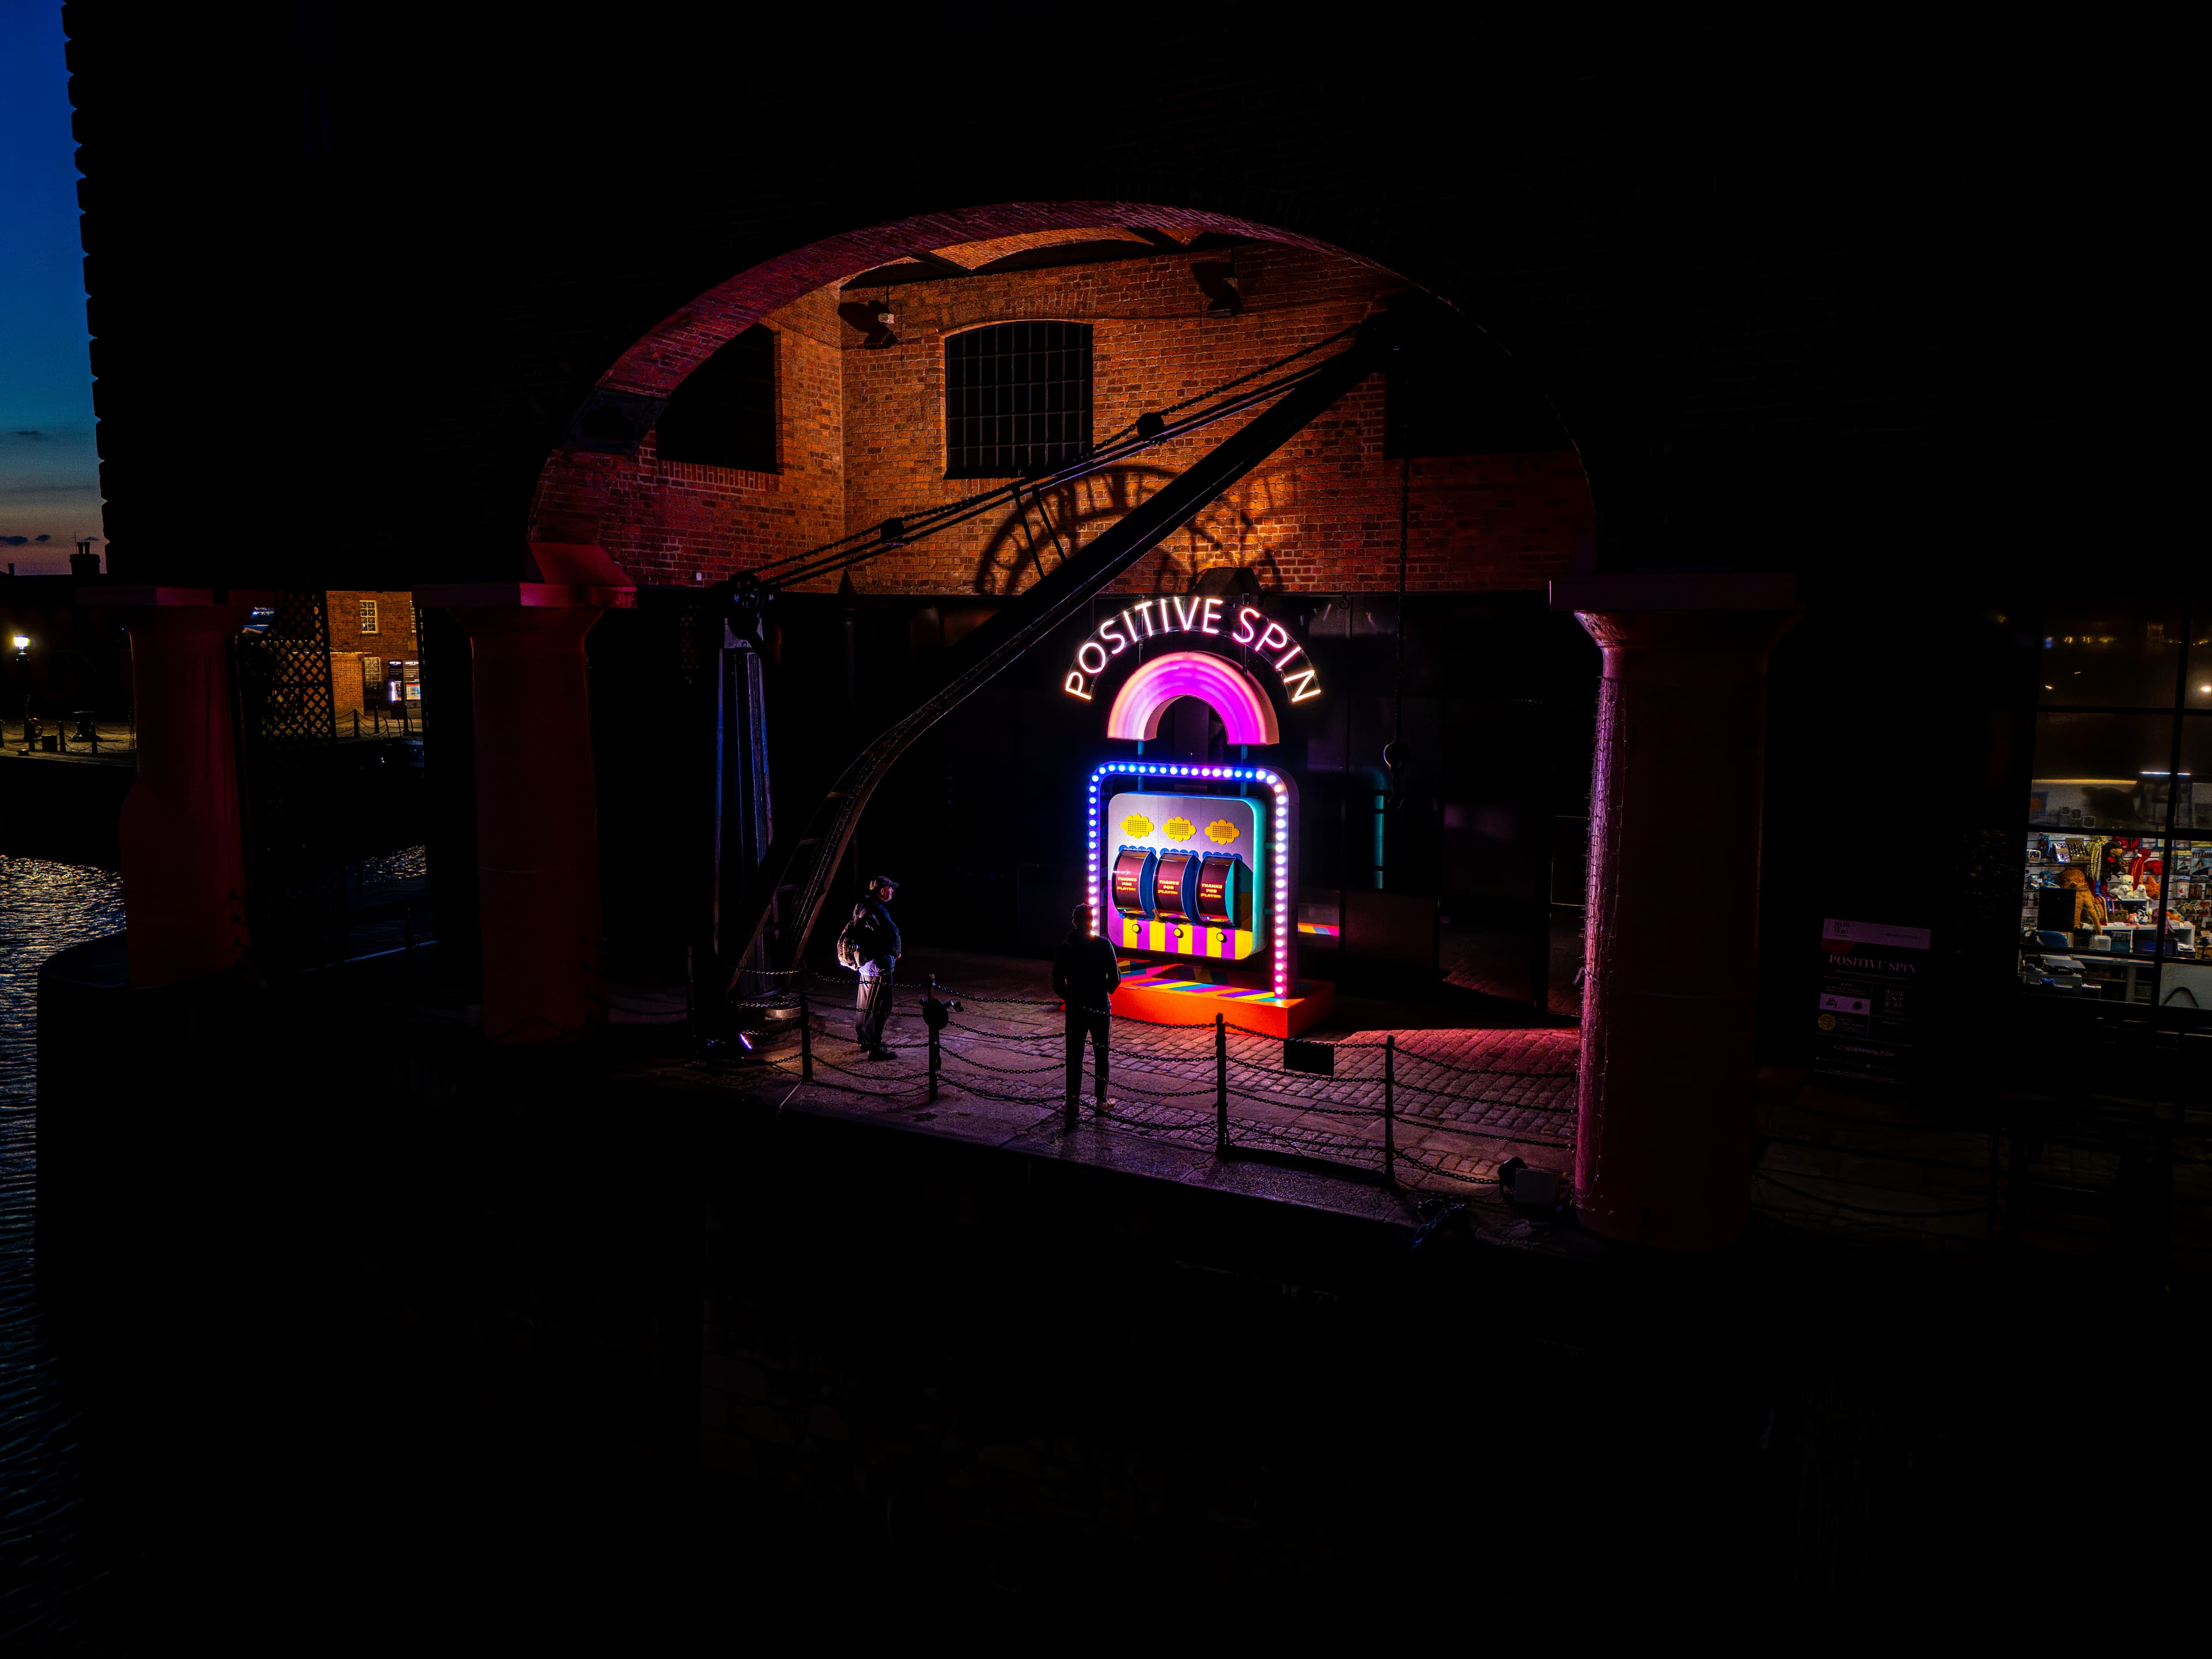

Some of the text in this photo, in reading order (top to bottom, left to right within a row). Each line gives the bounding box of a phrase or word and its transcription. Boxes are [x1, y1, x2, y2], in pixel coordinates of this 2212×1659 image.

[1065, 596, 1321, 703] POSITIVE SPIN
[1829, 955, 1917, 974] POSITIVE SPIN
